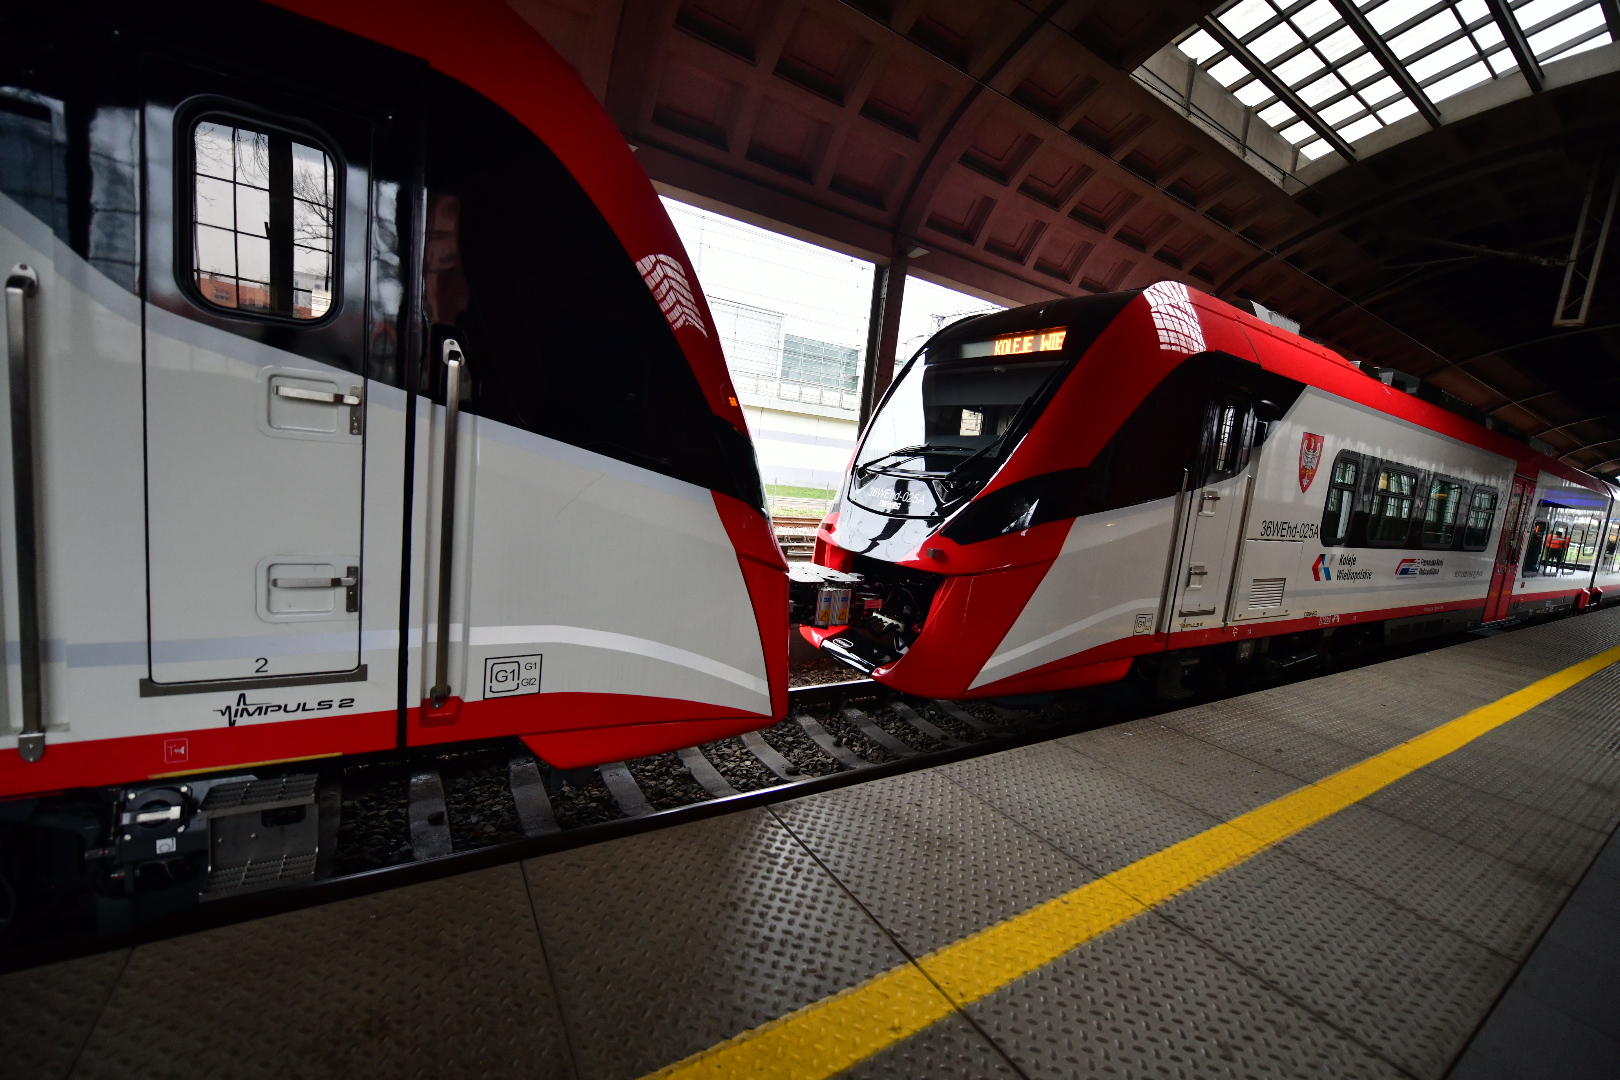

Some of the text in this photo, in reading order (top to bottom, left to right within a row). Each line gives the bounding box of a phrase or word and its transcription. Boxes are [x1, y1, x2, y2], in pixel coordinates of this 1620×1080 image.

[867, 486, 926, 505] 36WEhd-025A
[1260, 520, 1320, 539] 36WEhd-025A
[1339, 554, 1357, 566] Koleje
[1336, 568, 1373, 583] Wielkopolskie
[254, 657, 269, 673] 2
[524, 662, 537, 671] G1
[495, 668, 516, 683] G1
[232, 698, 355, 720] IMPULS 2
